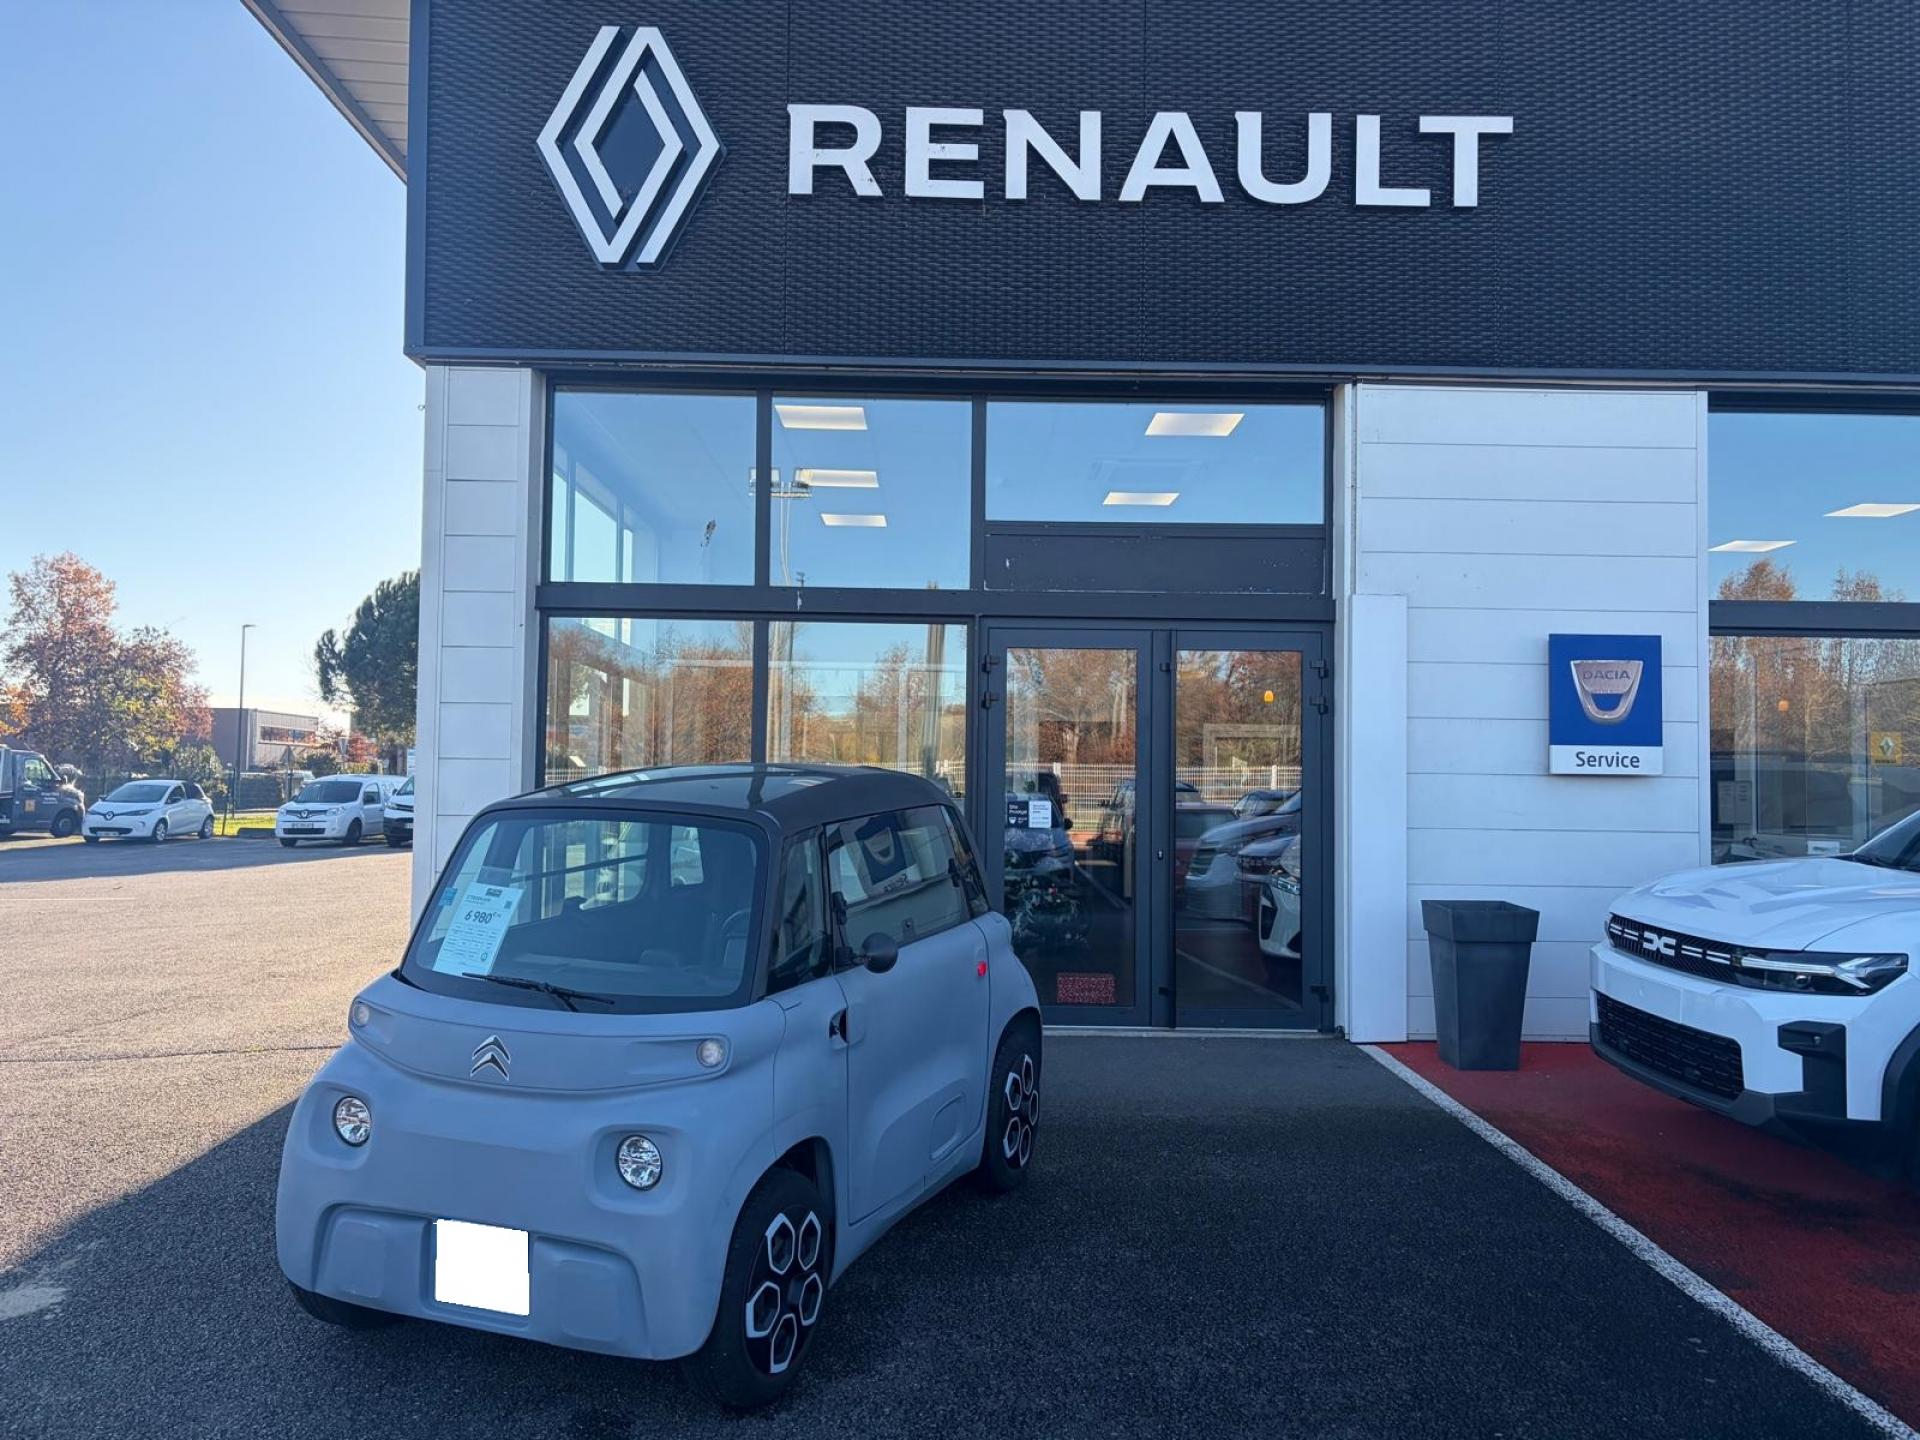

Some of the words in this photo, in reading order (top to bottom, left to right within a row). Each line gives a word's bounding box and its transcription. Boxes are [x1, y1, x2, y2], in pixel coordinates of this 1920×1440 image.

[787, 103, 1513, 207] RENAULT
[1583, 670, 1631, 680] DACIA
[1575, 751, 1641, 769] Service
